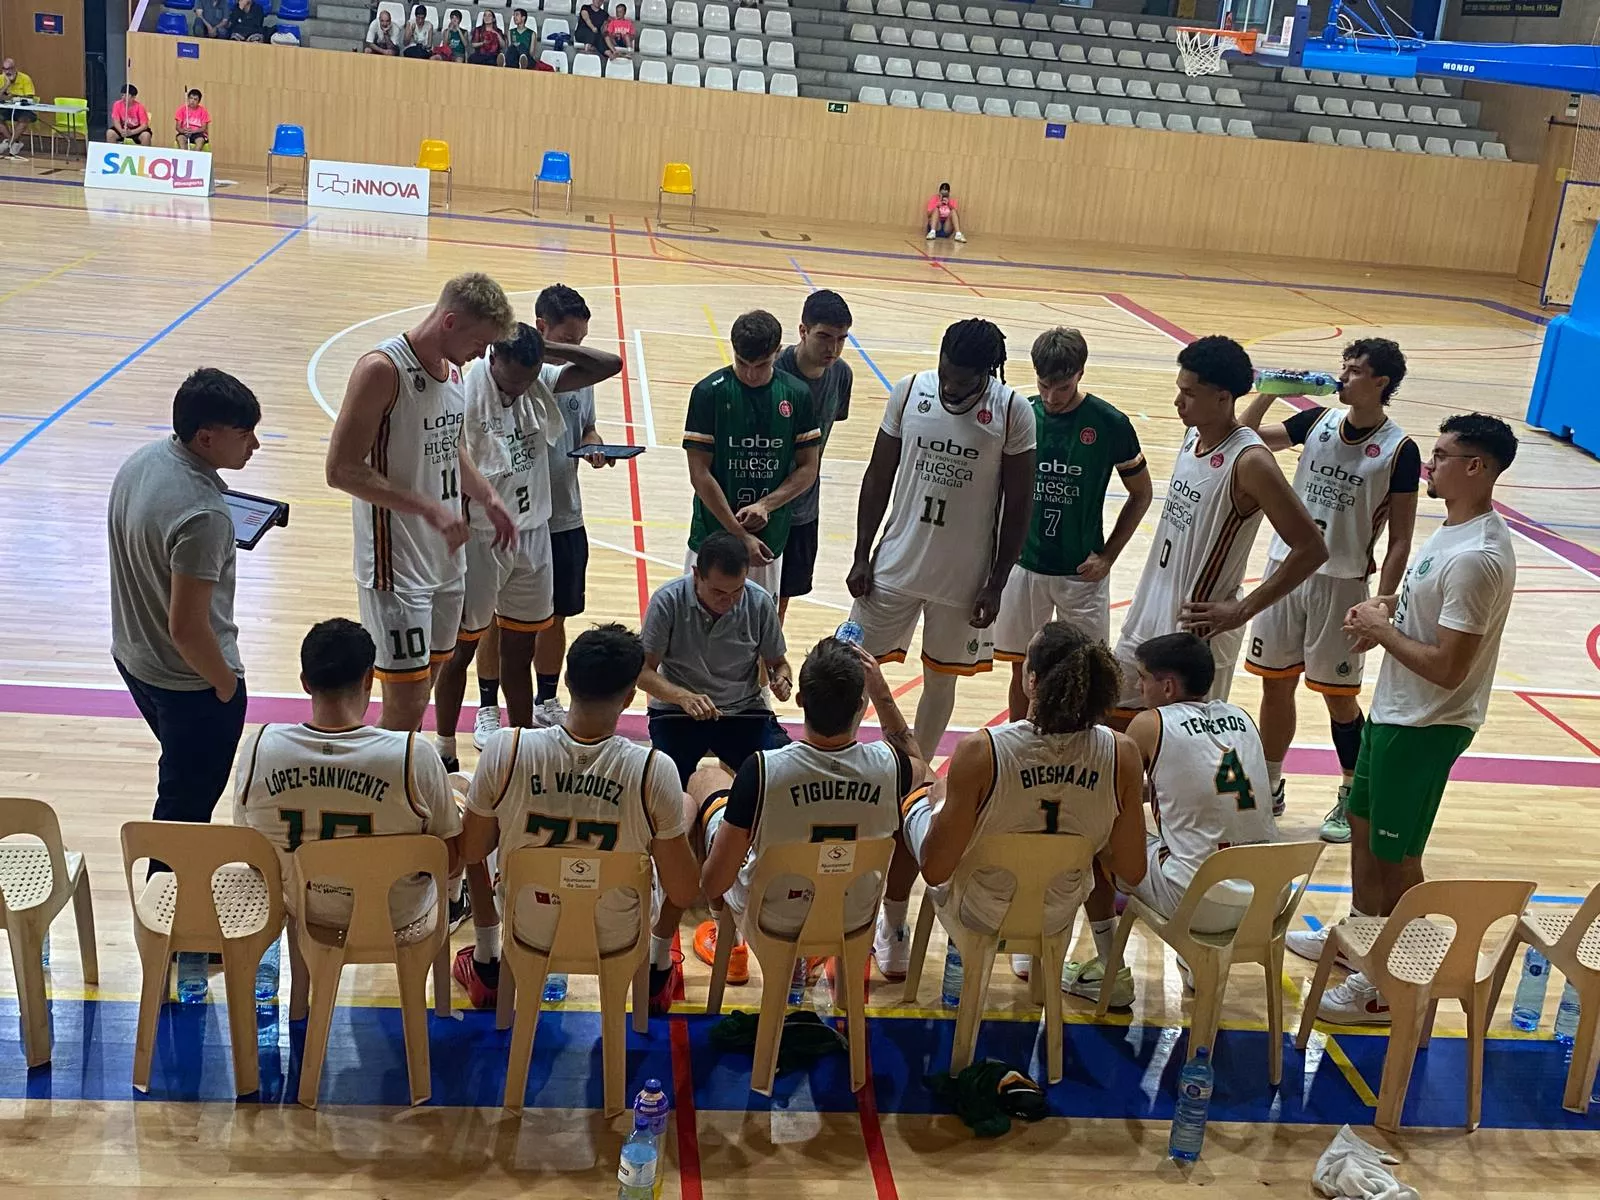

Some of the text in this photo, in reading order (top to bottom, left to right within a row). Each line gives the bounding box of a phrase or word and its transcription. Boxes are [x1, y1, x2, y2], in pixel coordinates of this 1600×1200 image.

[1442, 62, 1475, 73] MONDO
[101, 152, 194, 182] SALOU
[728, 434, 784, 449] Lobe
[917, 436, 979, 459] Lobe
[728, 457, 780, 471] Huesca
[915, 460, 973, 482] Huesca
[1038, 459, 1083, 476] obe
[1310, 460, 1364, 486] Lobe
[515, 485, 530, 515] 2
[1305, 481, 1355, 507] Huesca
[919, 495, 947, 528] 11
[1043, 508, 1061, 537] 7
[1159, 538, 1171, 569] 0
[389, 627, 427, 661] 10
[1251, 636, 1263, 658] 6
[264, 766, 391, 803] LÓPEZ-SANVICENTE
[530, 770, 625, 806] G. VÁZQUEZ
[1019, 764, 1099, 792] BIESHAAR
[1214, 746, 1257, 812] 4
[790, 780, 882, 807] FIGUEROA
